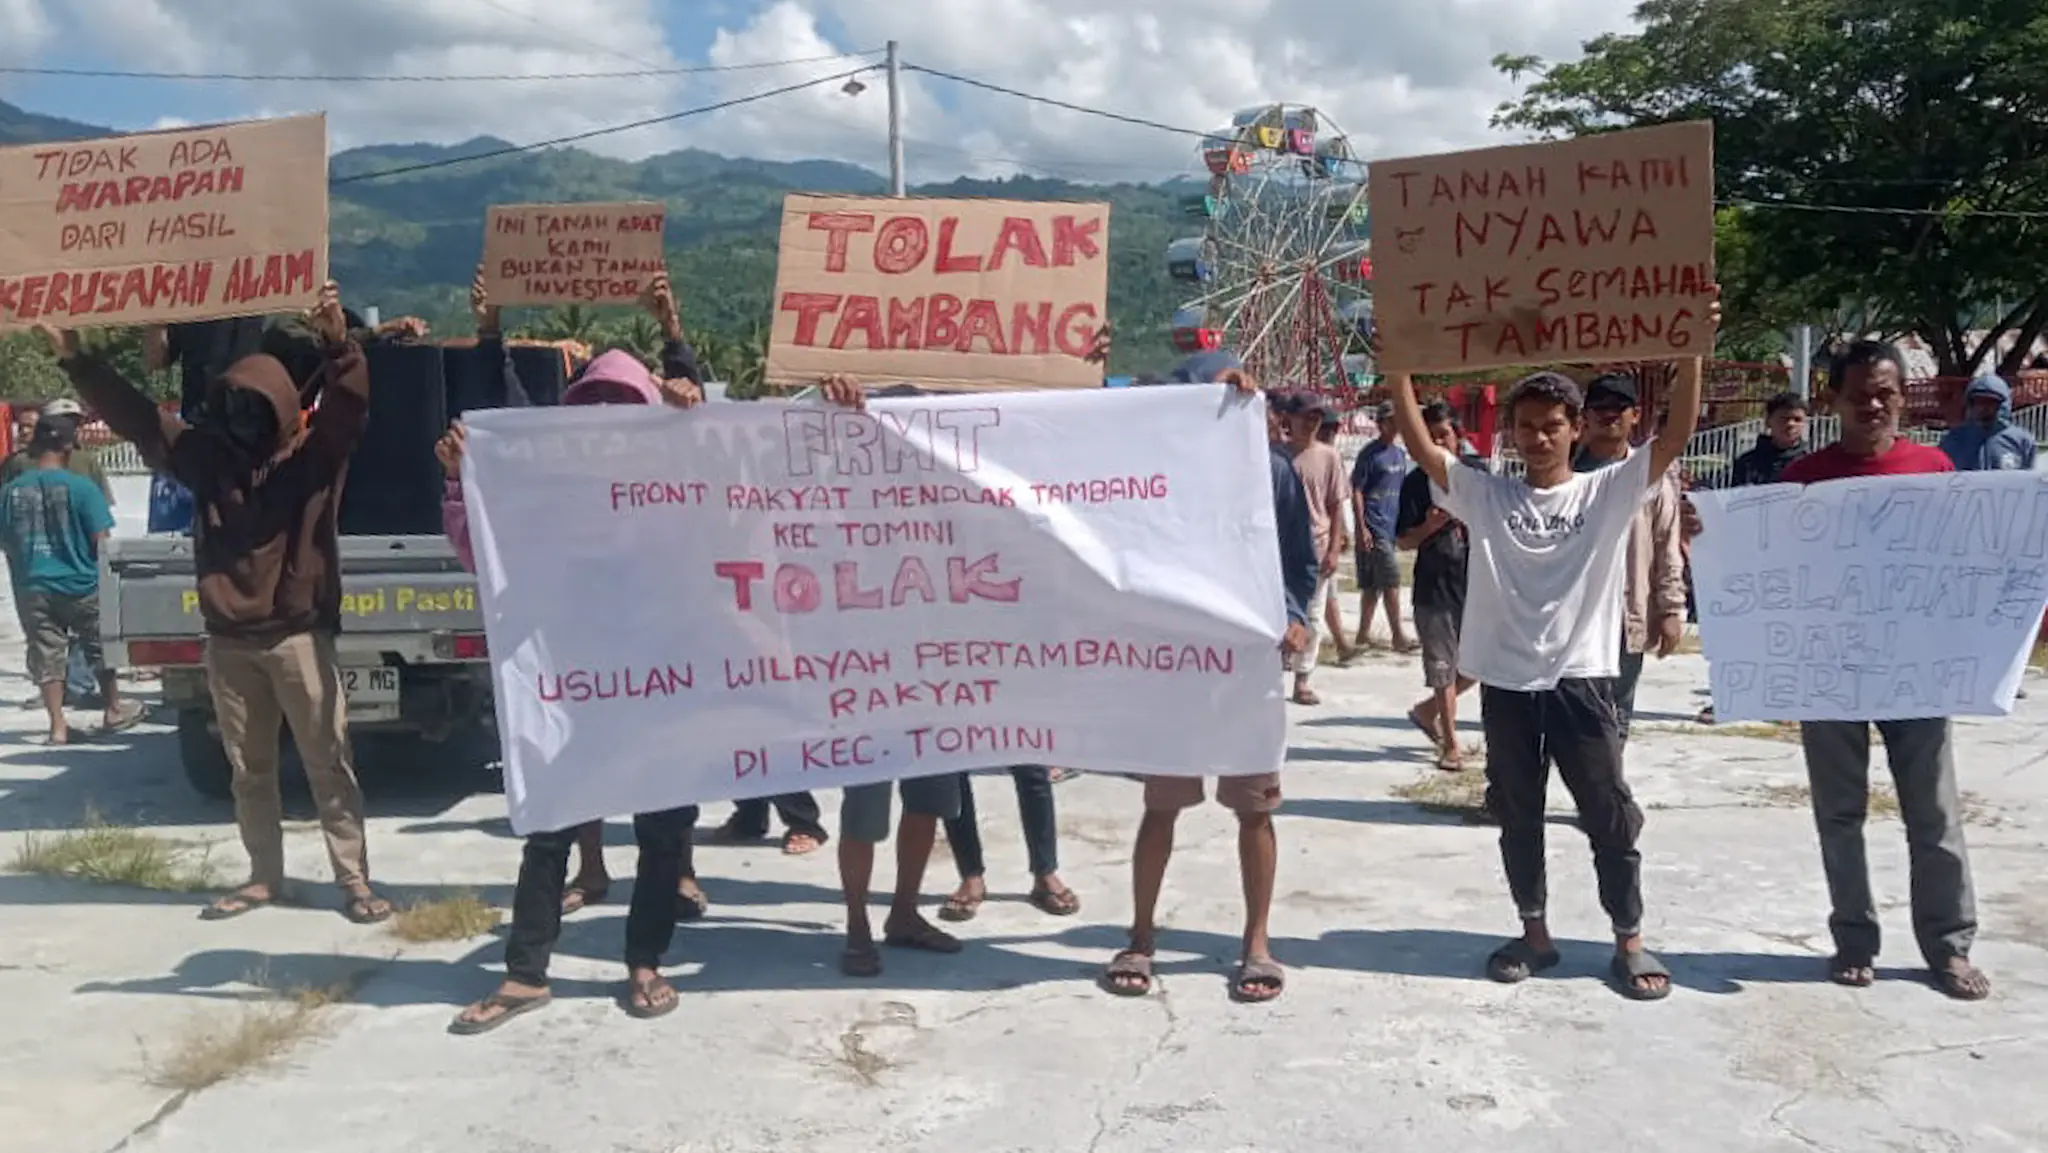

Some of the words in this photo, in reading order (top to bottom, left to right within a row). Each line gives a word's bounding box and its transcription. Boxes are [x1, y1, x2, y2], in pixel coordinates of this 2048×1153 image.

[33, 146, 137, 180] TIDAK
[169, 137, 232, 168] ADA
[1390, 166, 1548, 207] TANAH
[60, 221, 125, 251] DARI
[147, 212, 235, 245] HASIL
[534, 214, 608, 237] TANAH
[808, 212, 1099, 274] TOLAK
[1456, 206, 1657, 258] NYAWA
[222, 249, 314, 303] ALAM
[501, 258, 583, 278] BUKAN
[525, 278, 640, 300] INVESTOR
[1409, 276, 1512, 315] TAK
[781, 292, 1103, 357] TAMBANG
[1443, 307, 1695, 363] TAMBANG
[783, 405, 1000, 478] FRMT
[611, 480, 707, 513] FRONT
[726, 482, 851, 512] RAKYAT
[1030, 474, 1168, 506] TAMBANG
[773, 522, 818, 548] KEC
[837, 519, 955, 547] TOMINI
[342, 588, 384, 616] api
[396, 586, 475, 613] Pasti
[714, 552, 1022, 613] TOLAK
[537, 660, 695, 703] USULAN
[725, 650, 892, 689] WILAYAH
[914, 638, 1235, 674] PERTAMBANGAN
[829, 678, 1000, 719] RAKYAT
[733, 746, 768, 780] DI
[904, 725, 1054, 758] TOMINI
